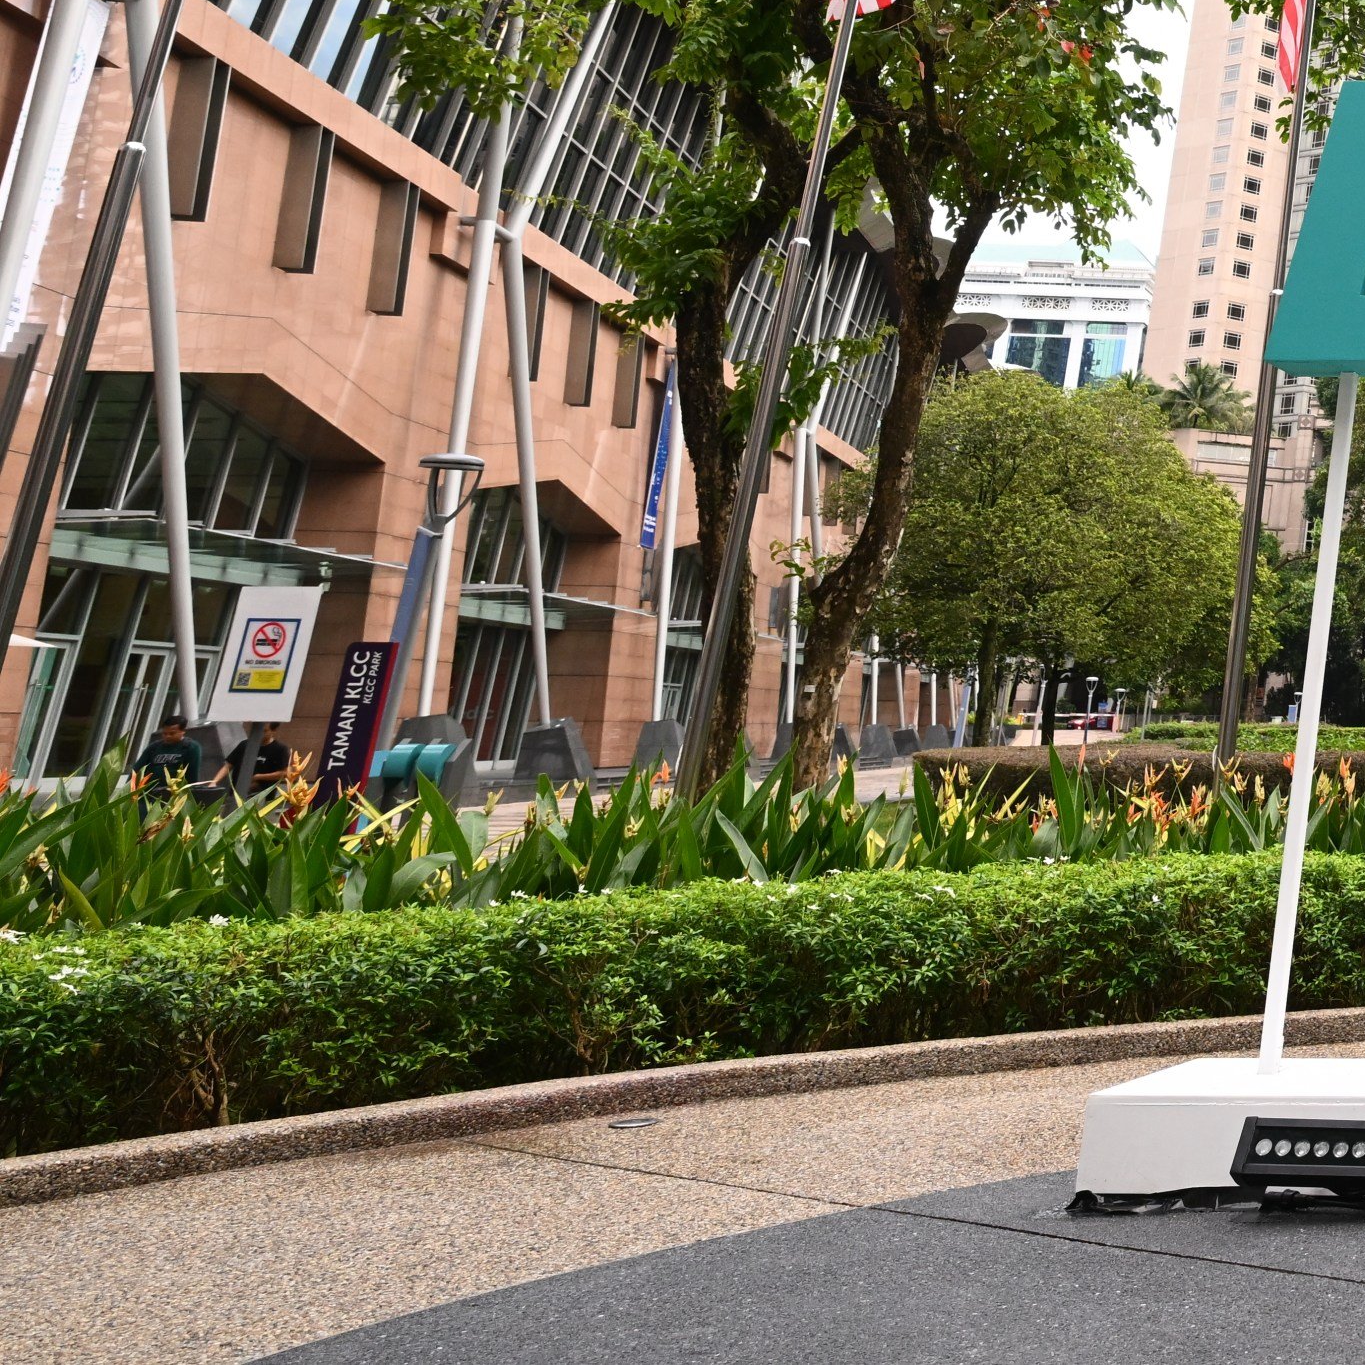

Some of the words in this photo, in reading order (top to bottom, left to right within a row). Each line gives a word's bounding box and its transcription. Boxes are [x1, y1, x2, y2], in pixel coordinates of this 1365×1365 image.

[369, 651, 383, 677] PARK
[363, 678, 376, 704] KLCC
[327, 705, 358, 771] TAMAN
[344, 651, 371, 699] KLCC
